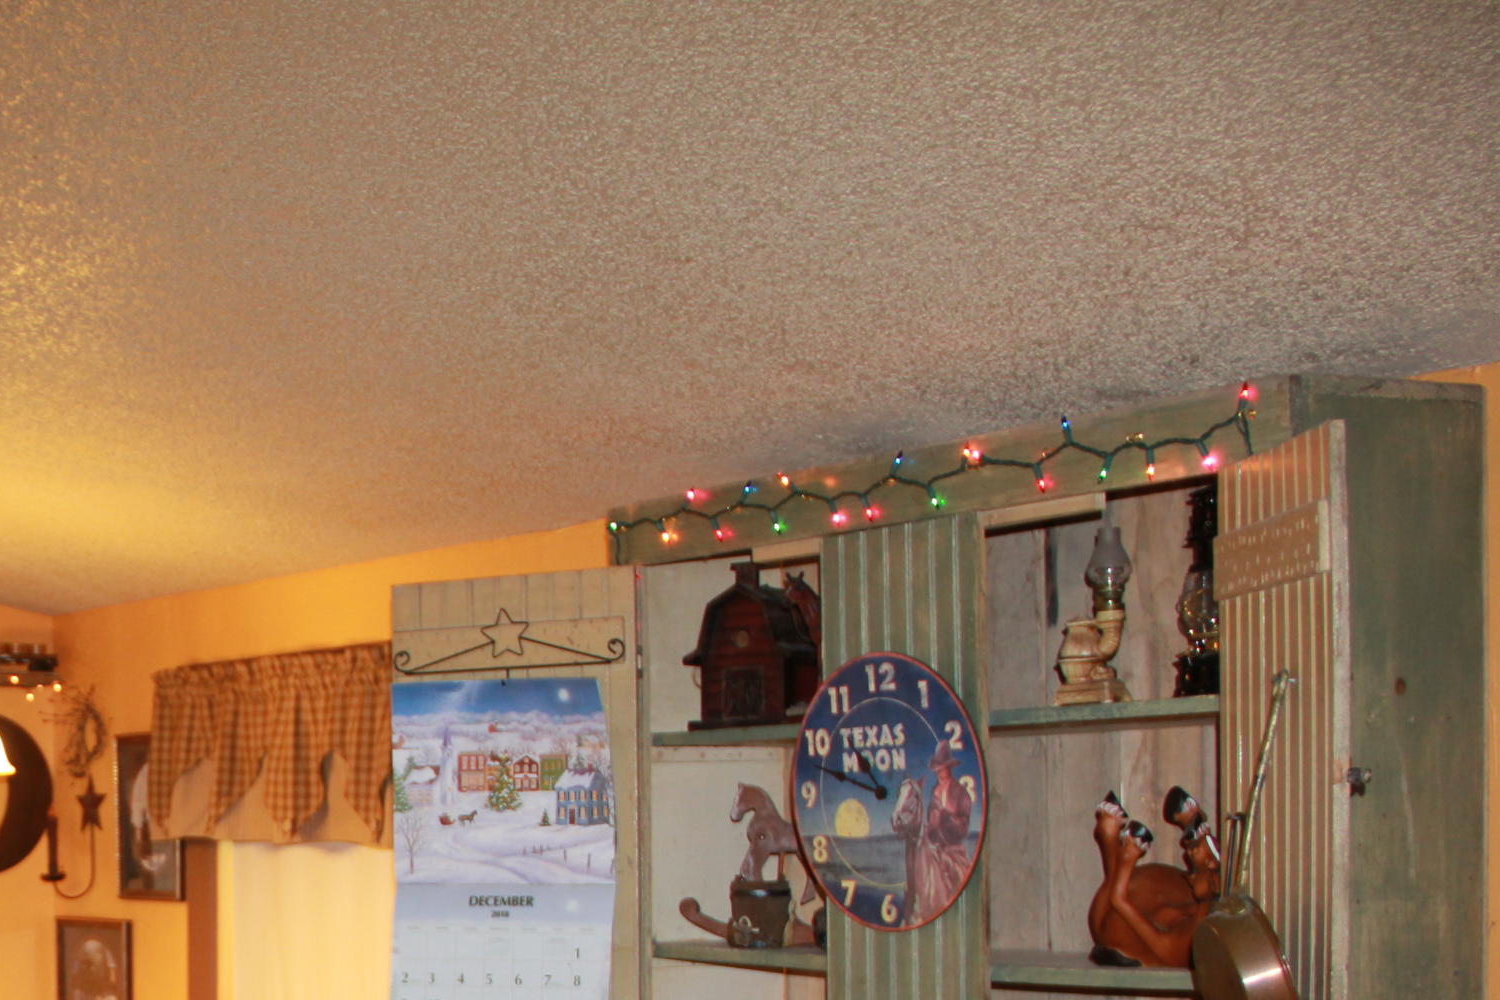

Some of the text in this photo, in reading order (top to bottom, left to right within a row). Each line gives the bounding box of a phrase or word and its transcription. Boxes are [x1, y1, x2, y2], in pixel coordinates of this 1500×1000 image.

[864, 662, 896, 692] 12
[828, 686, 850, 714] 11
[918, 680, 929, 708] 1
[805, 728, 830, 756] 10
[840, 724, 906, 748] TEXAS
[945, 721, 962, 749] 2
[802, 781, 818, 808] 9
[812, 836, 828, 864] 8
[469, 896, 534, 907] DECEMBER
[841, 880, 857, 907] 7
[881, 894, 898, 922] 6
[575, 947, 580, 959] 1
[401, 973, 581, 986] 2 3 4 5 6 7 8
